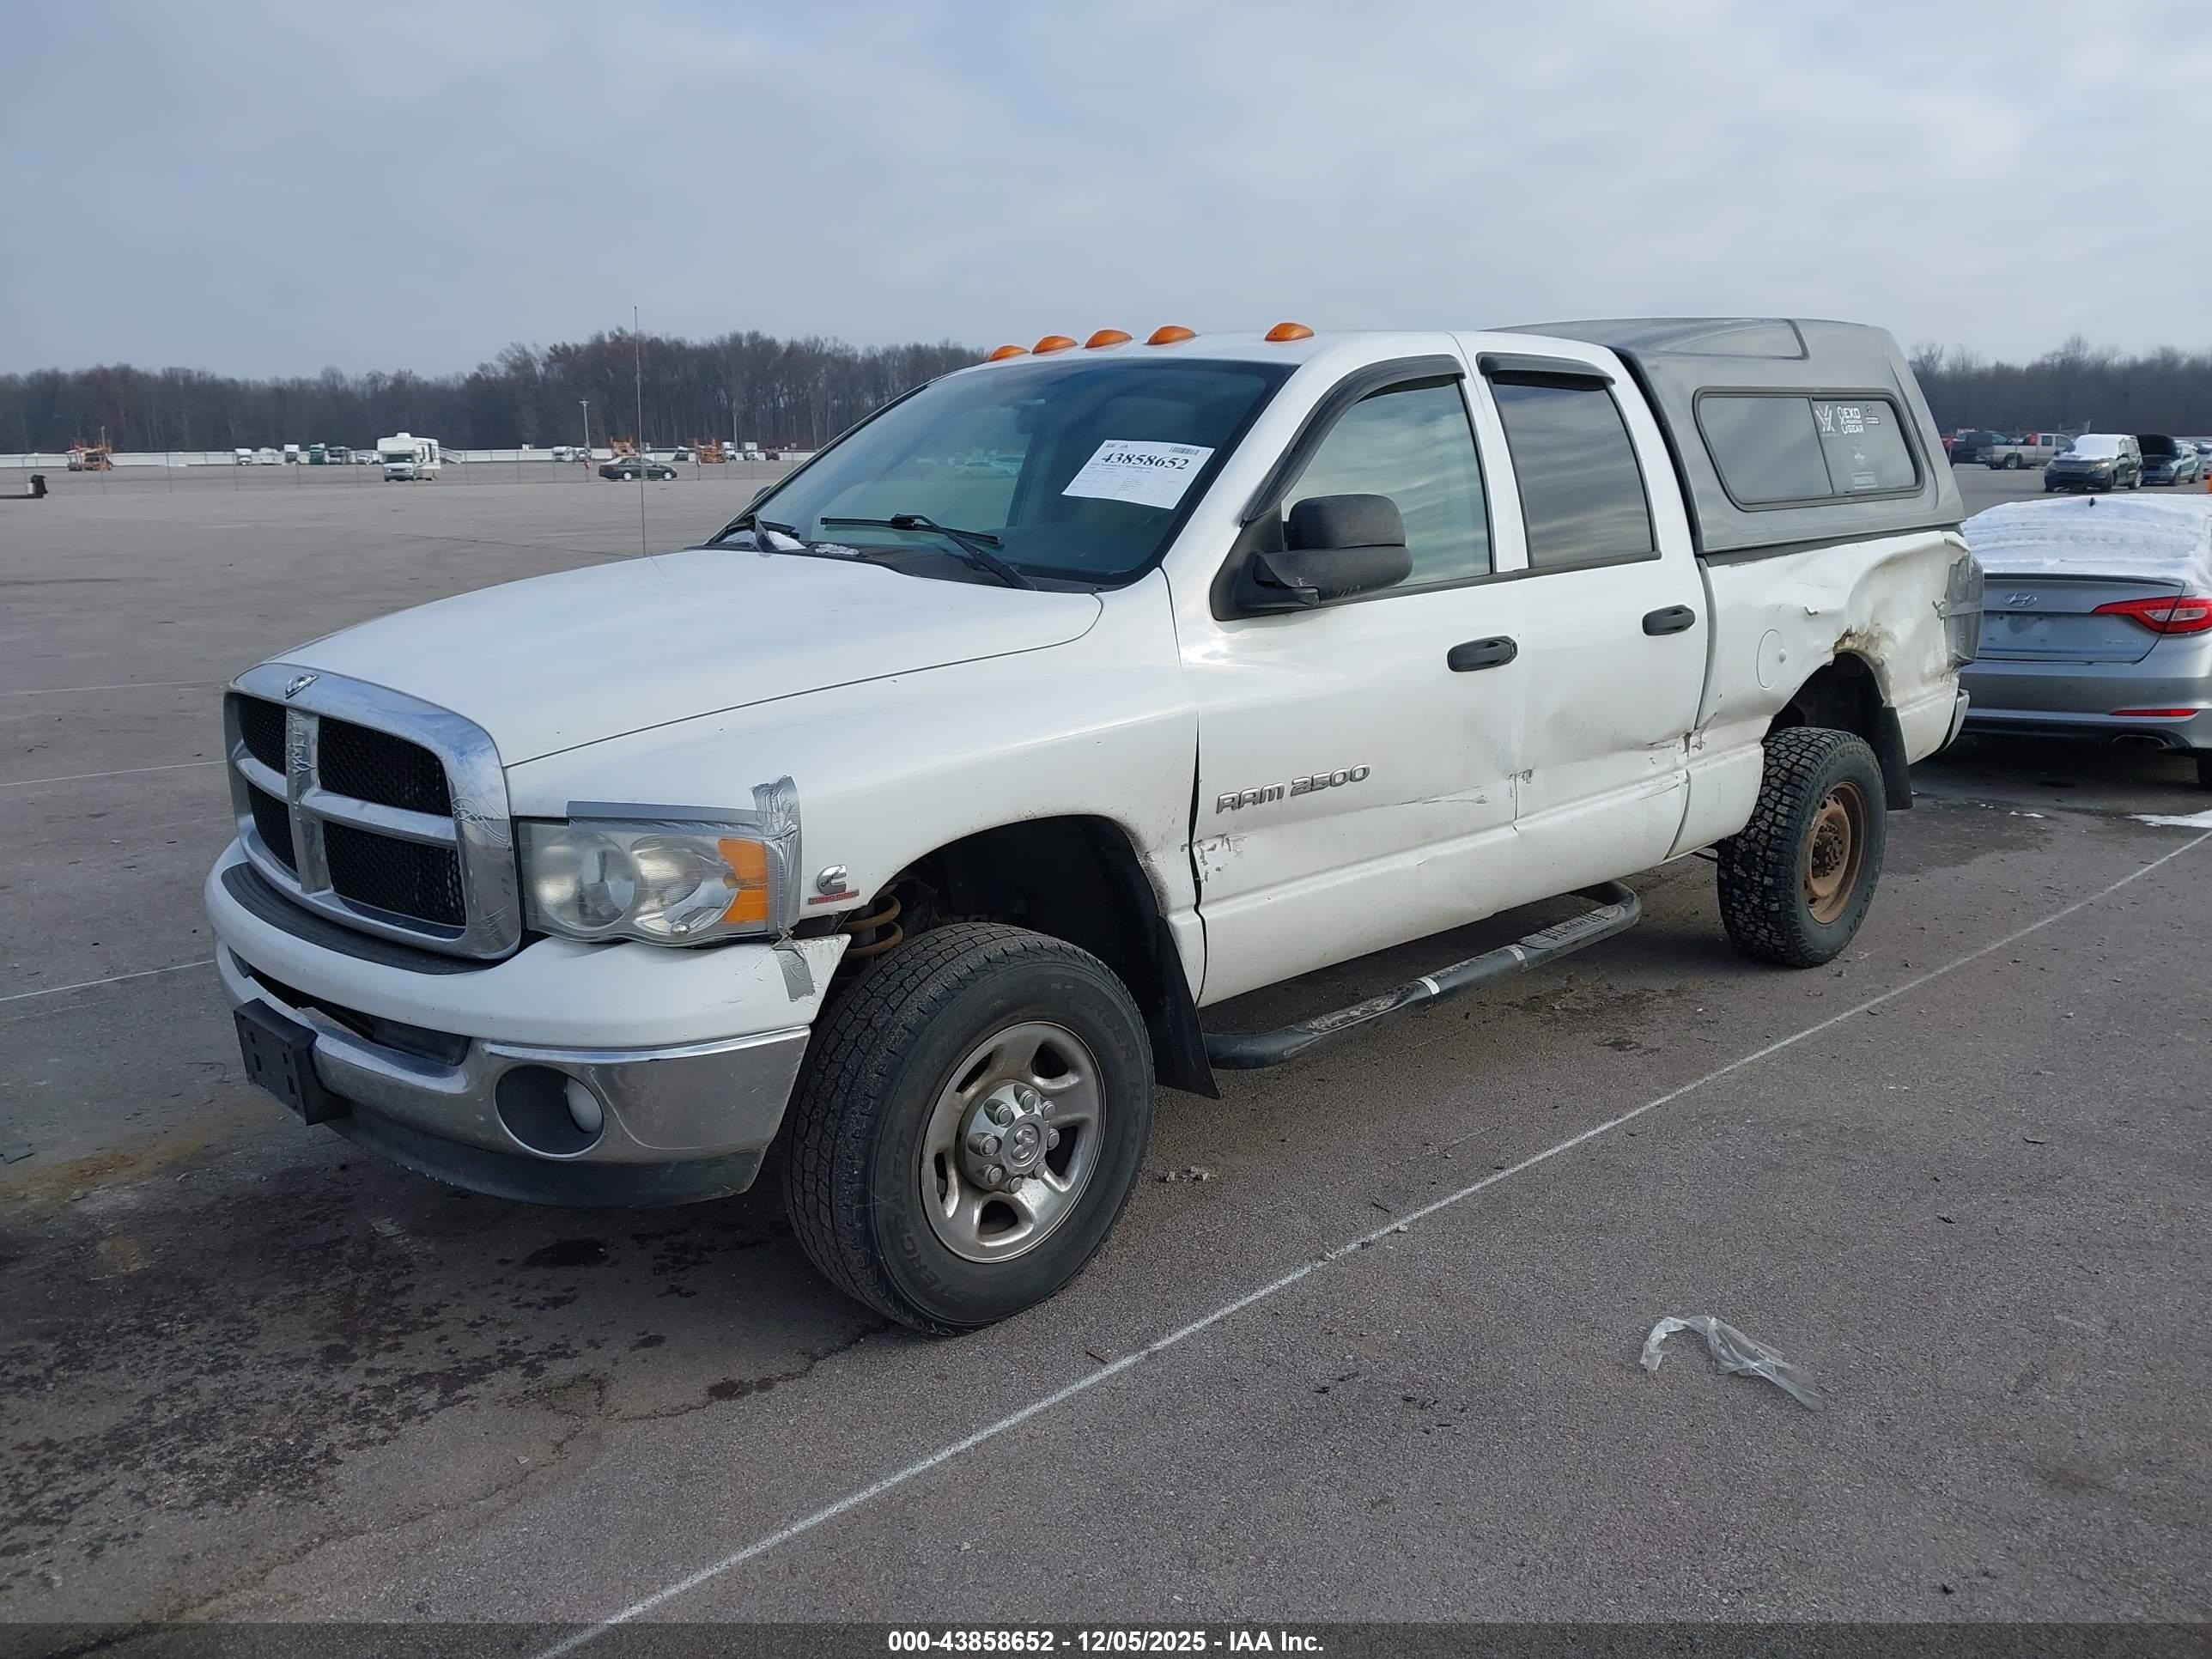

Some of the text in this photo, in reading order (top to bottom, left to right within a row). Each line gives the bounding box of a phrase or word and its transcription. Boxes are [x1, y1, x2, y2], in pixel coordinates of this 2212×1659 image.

[1102, 453, 1189, 470] 43858652
[1216, 763, 1370, 814] RAM 2500
